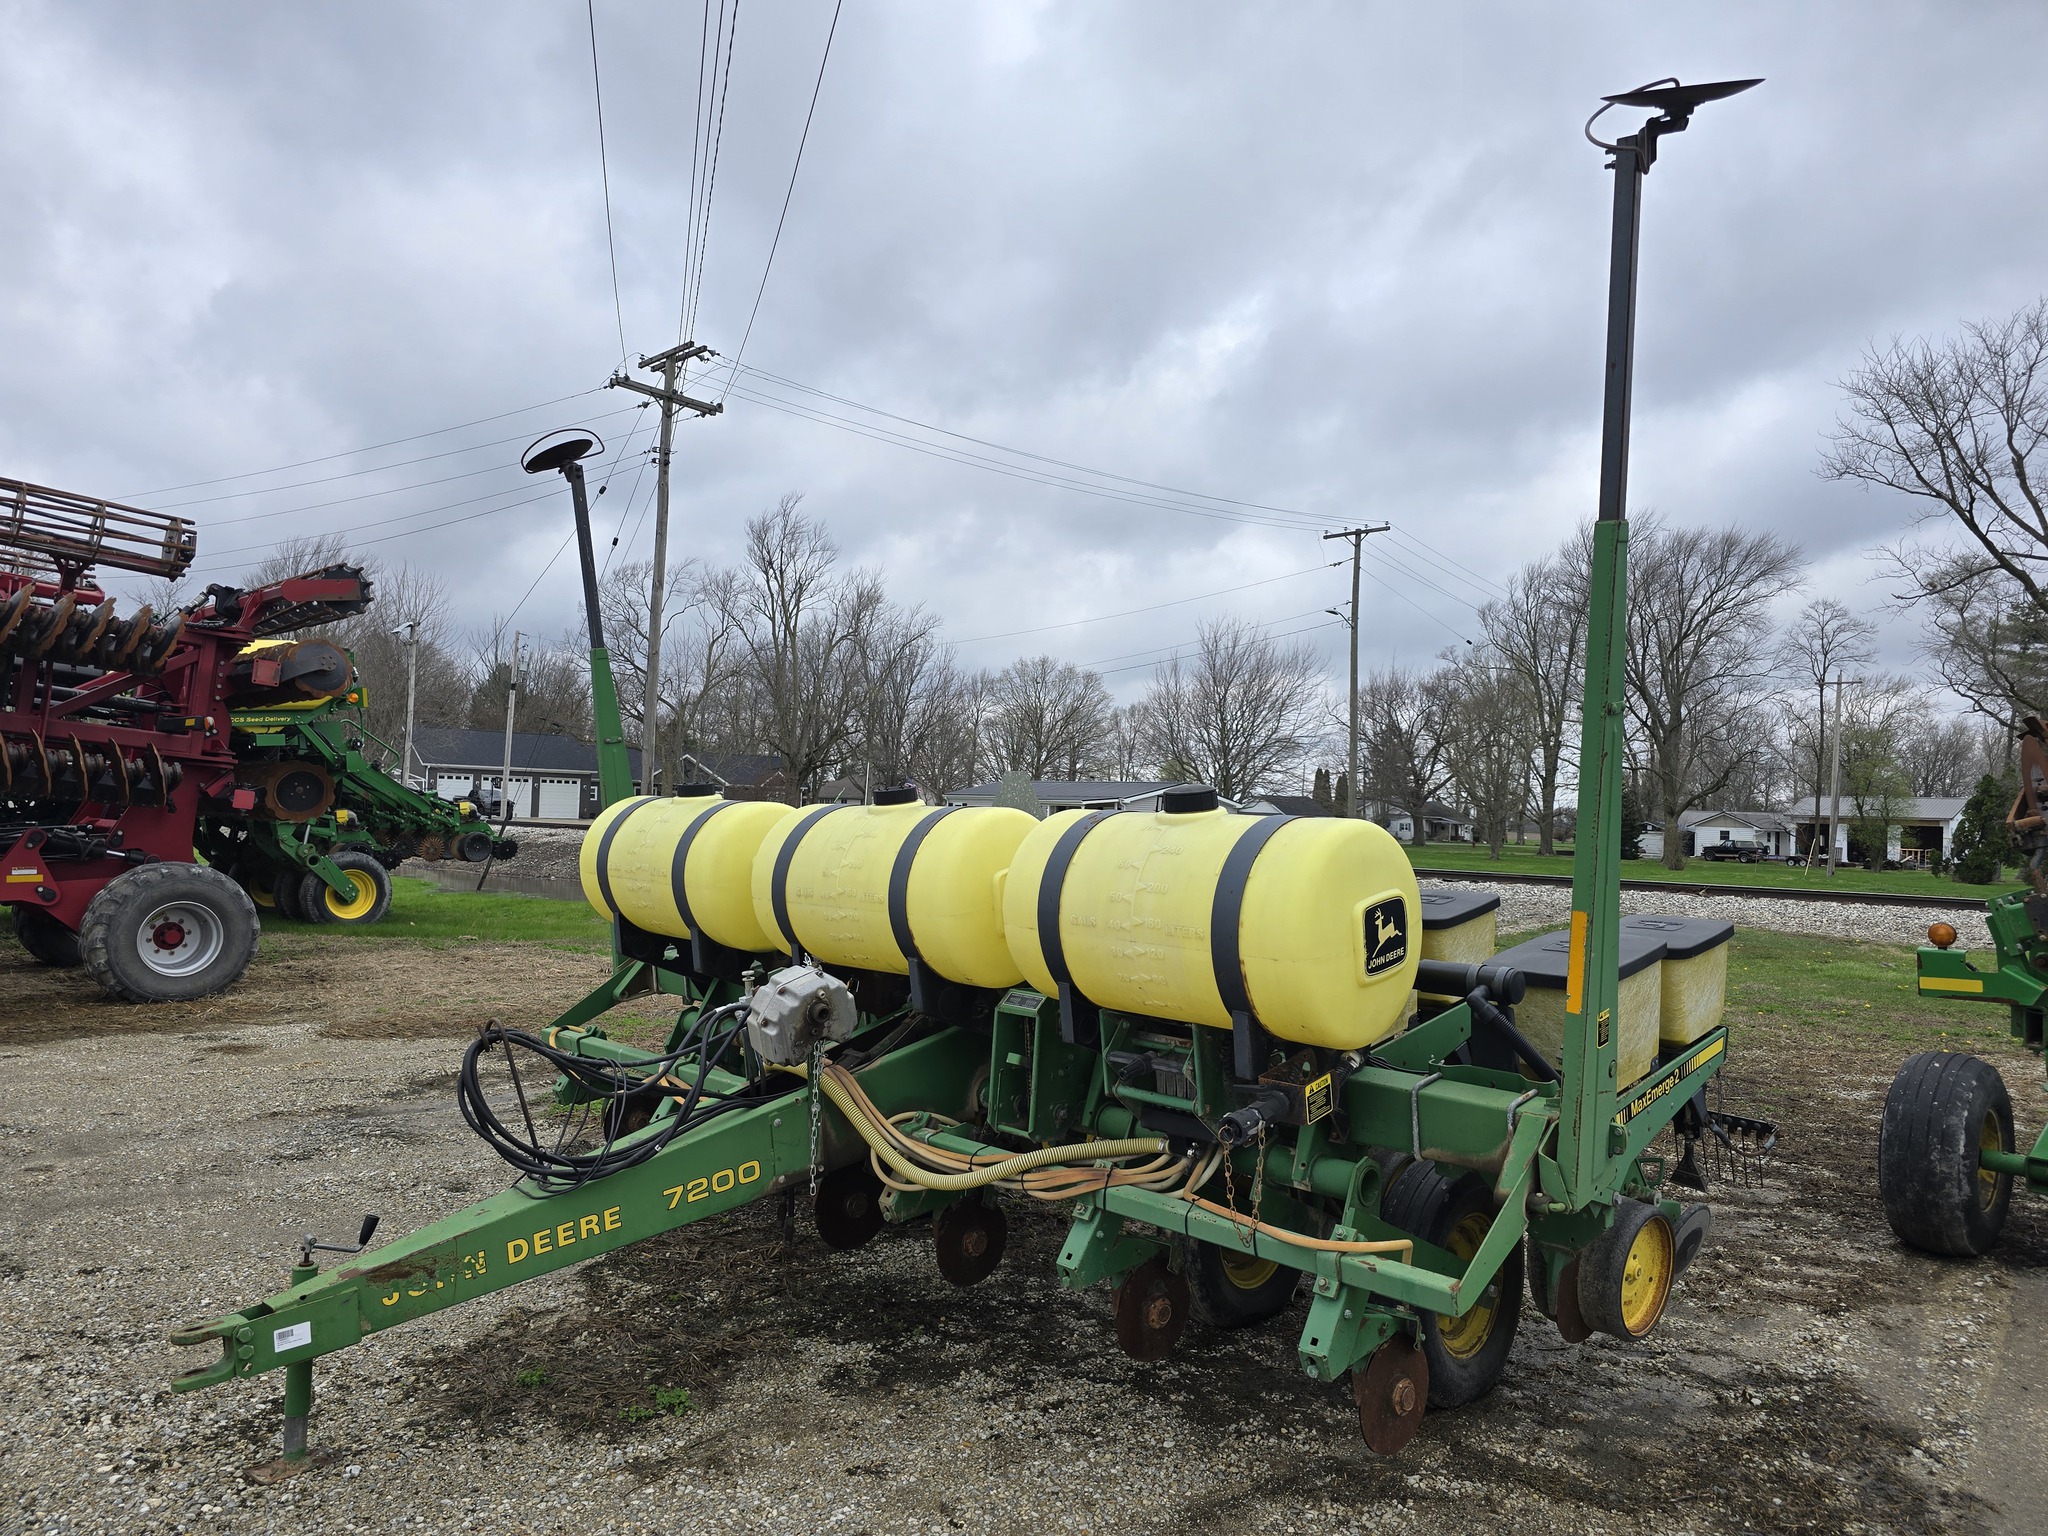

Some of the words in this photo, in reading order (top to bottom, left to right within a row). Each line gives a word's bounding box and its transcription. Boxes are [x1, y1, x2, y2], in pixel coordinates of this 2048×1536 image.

[1108, 891, 1123, 903] 50
[1146, 882, 1169, 895] 200
[1069, 914, 1097, 928] GALS
[1107, 919, 1122, 930] 40
[1142, 916, 1162, 930] 160
[1164, 923, 1205, 940] LITERS
[1146, 947, 1166, 960] 120
[1368, 954, 1386, 970] JOHN
[1385, 946, 1405, 962] DEERE
[1630, 1076, 1675, 1118] MaxEmerge
[1674, 1068, 1680, 1084] 2
[381, 1250, 488, 1307] JN
[505, 1205, 623, 1266] DEERE
[661, 1159, 762, 1211] 7200
